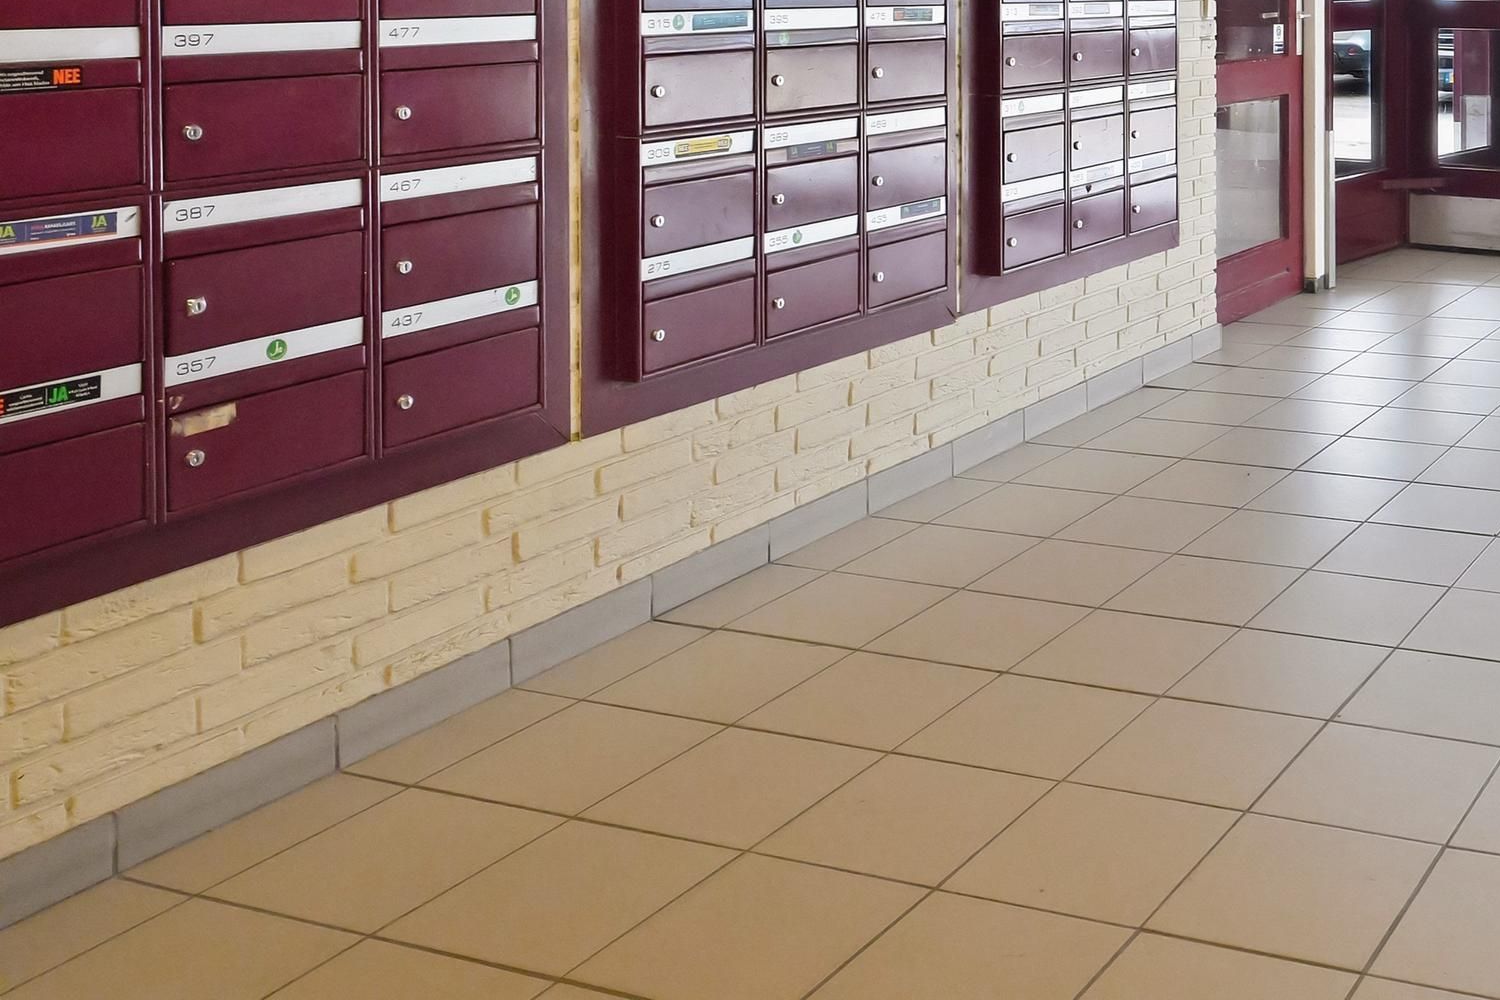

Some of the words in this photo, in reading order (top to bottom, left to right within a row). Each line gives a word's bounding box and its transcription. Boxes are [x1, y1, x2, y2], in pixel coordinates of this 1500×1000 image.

[174, 33, 214, 47] 397
[389, 27, 420, 38] 477
[53, 68, 81, 86] NEE
[647, 147, 670, 160] 309
[389, 179, 421, 192] 467
[175, 205, 215, 222] 387
[91, 215, 108, 228] JA
[391, 312, 423, 328] 437
[176, 356, 216, 376] 357
[49, 386, 69, 404] JA
